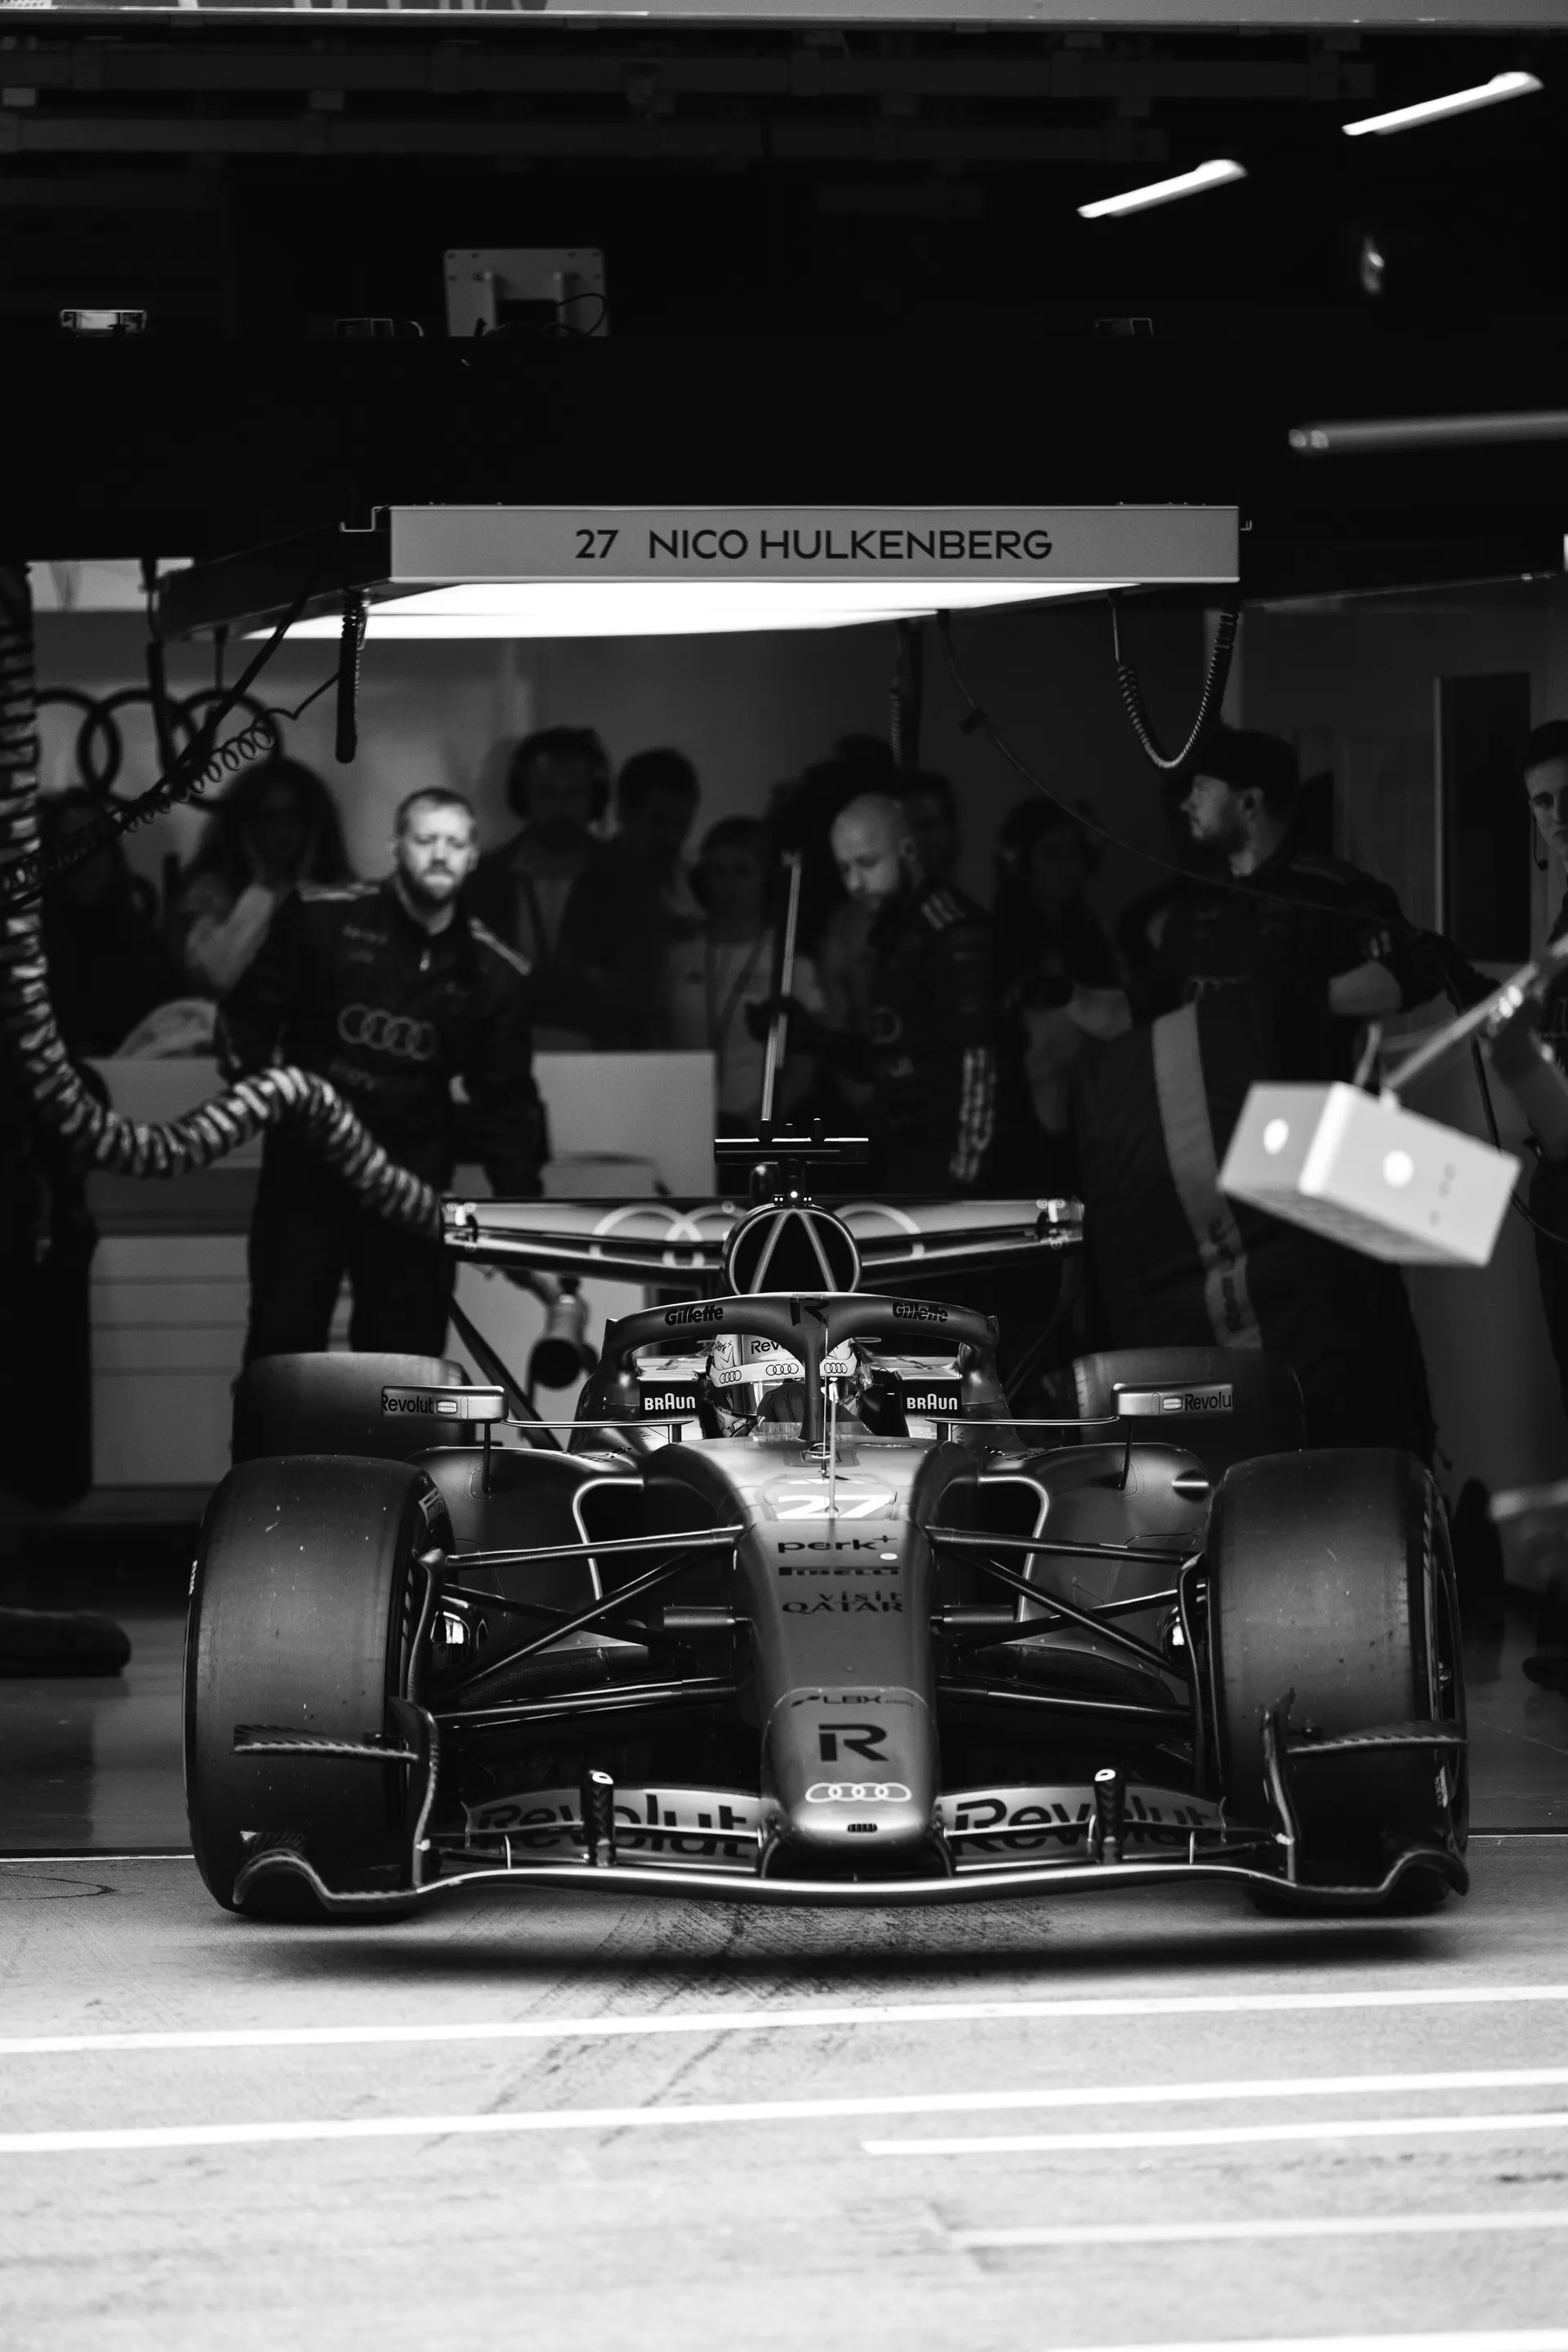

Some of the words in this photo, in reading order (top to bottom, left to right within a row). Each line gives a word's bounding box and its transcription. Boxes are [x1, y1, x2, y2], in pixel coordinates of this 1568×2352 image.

[575, 529, 618, 559] 27
[648, 529, 748, 559] NICO
[760, 529, 1053, 559] HULKENBERG
[664, 1304, 724, 1326] Gillette
[893, 1302, 948, 1323] Gillette
[751, 1340, 783, 1355] Rev
[381, 1393, 434, 1414] Revolut
[777, 1494, 893, 1519] 27
[782, 1601, 904, 1615] QATAR
[953, 1795, 1211, 1855] Revlut
